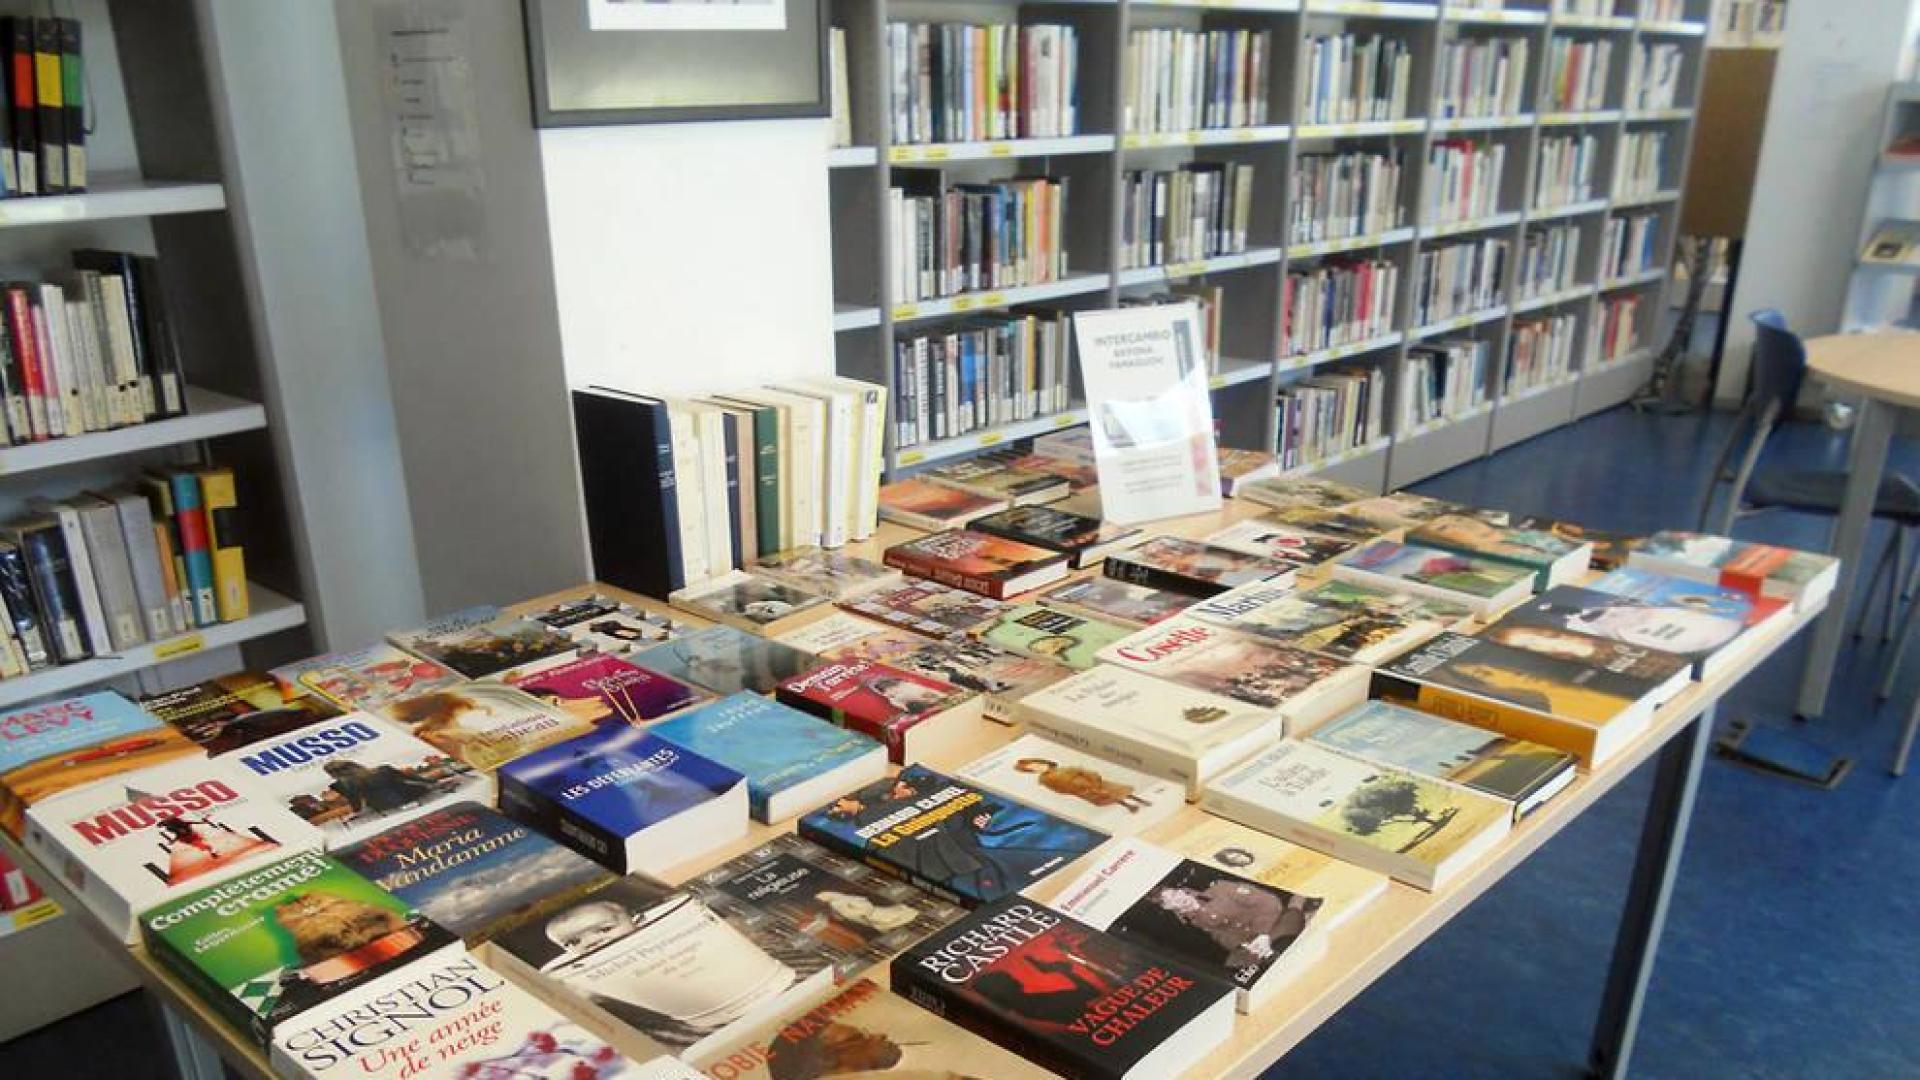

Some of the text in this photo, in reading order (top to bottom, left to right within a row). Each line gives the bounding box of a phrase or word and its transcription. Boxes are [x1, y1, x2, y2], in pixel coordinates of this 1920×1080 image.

[240, 721, 380, 777] MUSSO
[72, 779, 239, 846] MUSSO
[374, 827, 529, 893] Vandamme
[394, 828, 483, 869] Maria
[150, 846, 328, 931] Complètement
[919, 904, 1034, 973] RICHARD
[940, 909, 1061, 984] CASTLE
[286, 958, 480, 1052] CHRISTIAN
[302, 976, 506, 1071] SIGNOL
[1069, 966, 1171, 1035] VAGUE DE
[1090, 974, 1195, 1047] CHALEUR
[357, 1000, 503, 1074] Une année
[399, 1020, 503, 1080] de neige
[707, 1041, 777, 1080] OBIE
